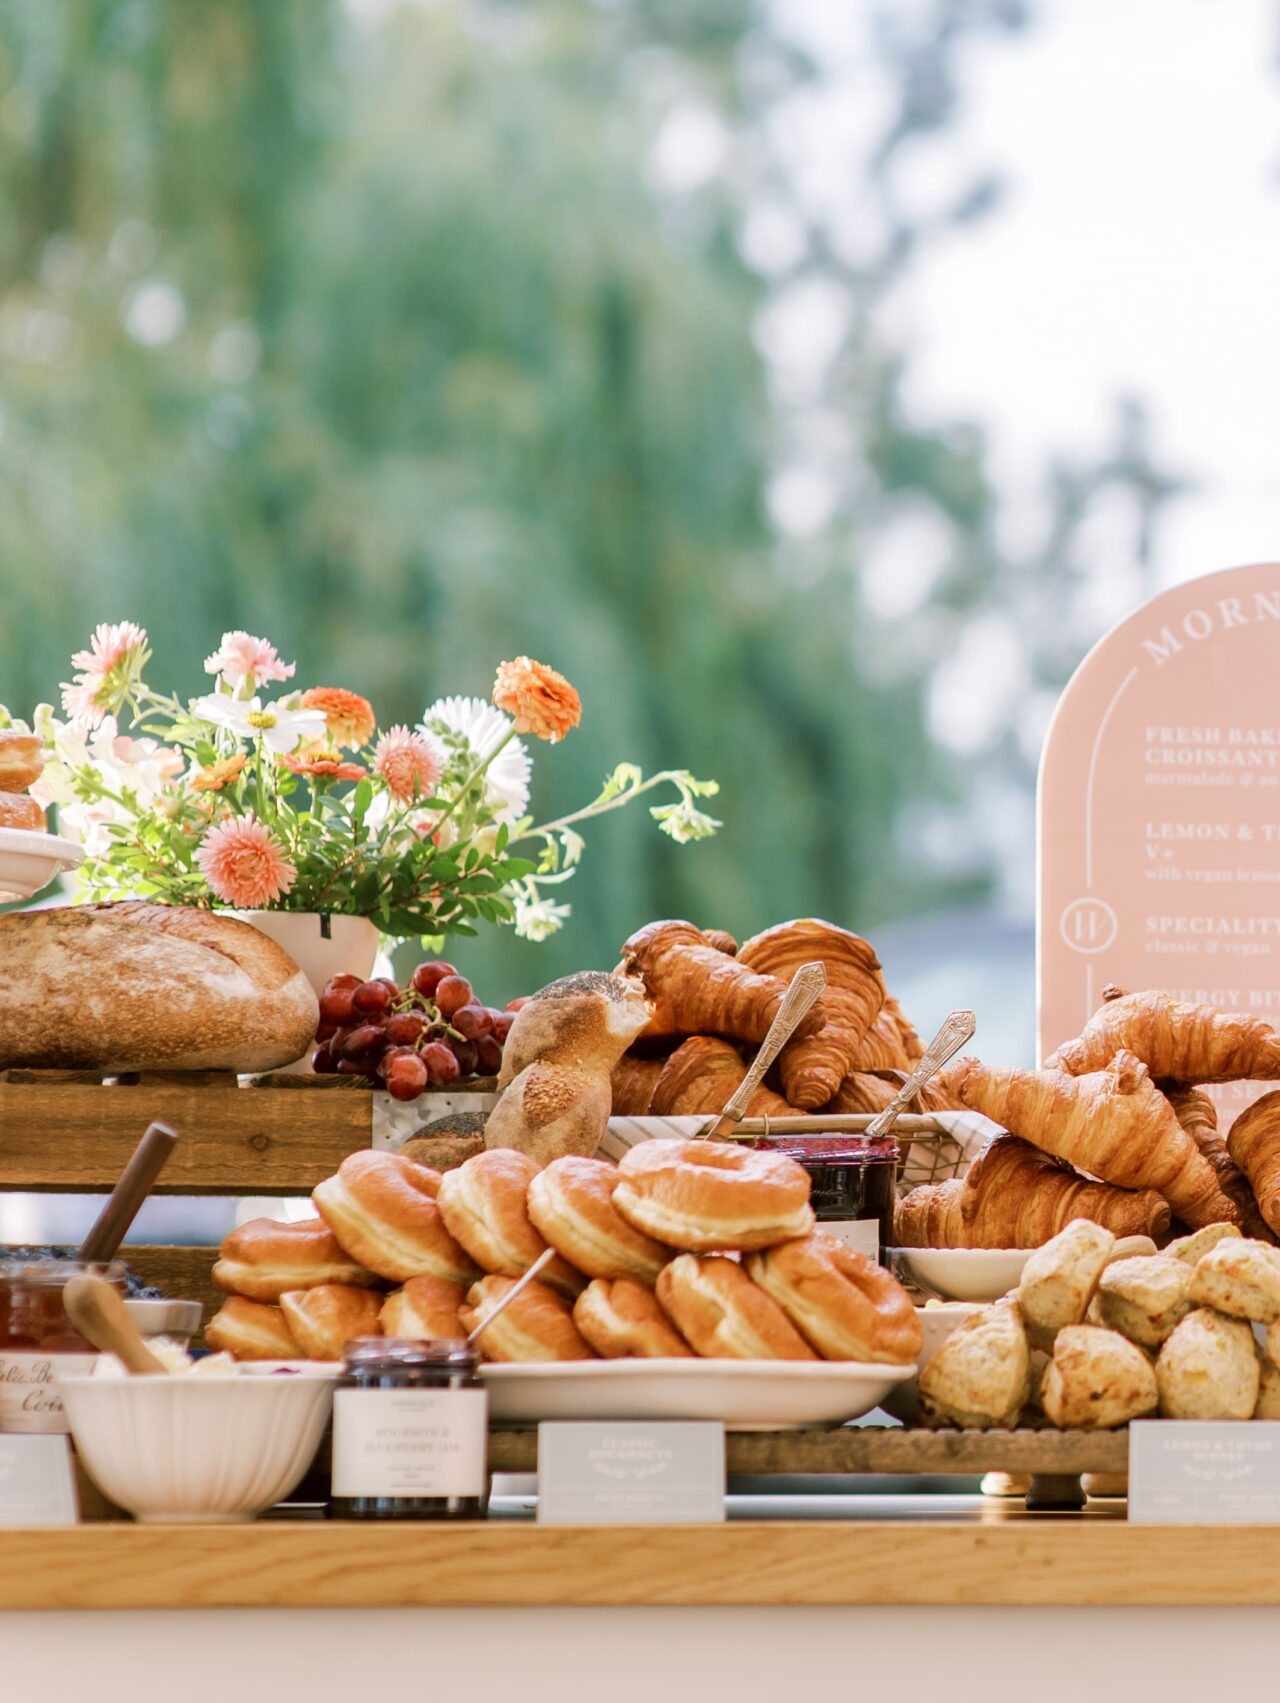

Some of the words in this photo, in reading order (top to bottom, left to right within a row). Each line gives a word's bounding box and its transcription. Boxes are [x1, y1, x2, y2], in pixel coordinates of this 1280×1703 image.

[1144, 726, 1221, 745] FRESH
[1144, 771, 1235, 786] marmalade
[1145, 822, 1230, 841] LEMON
[1237, 824, 1254, 842] &
[1144, 843, 1176, 861] V+
[1144, 865, 1181, 881] with
[1185, 869, 1233, 885] vegan
[1144, 939, 1200, 955] classic
[1223, 942, 1271, 957] vegan
